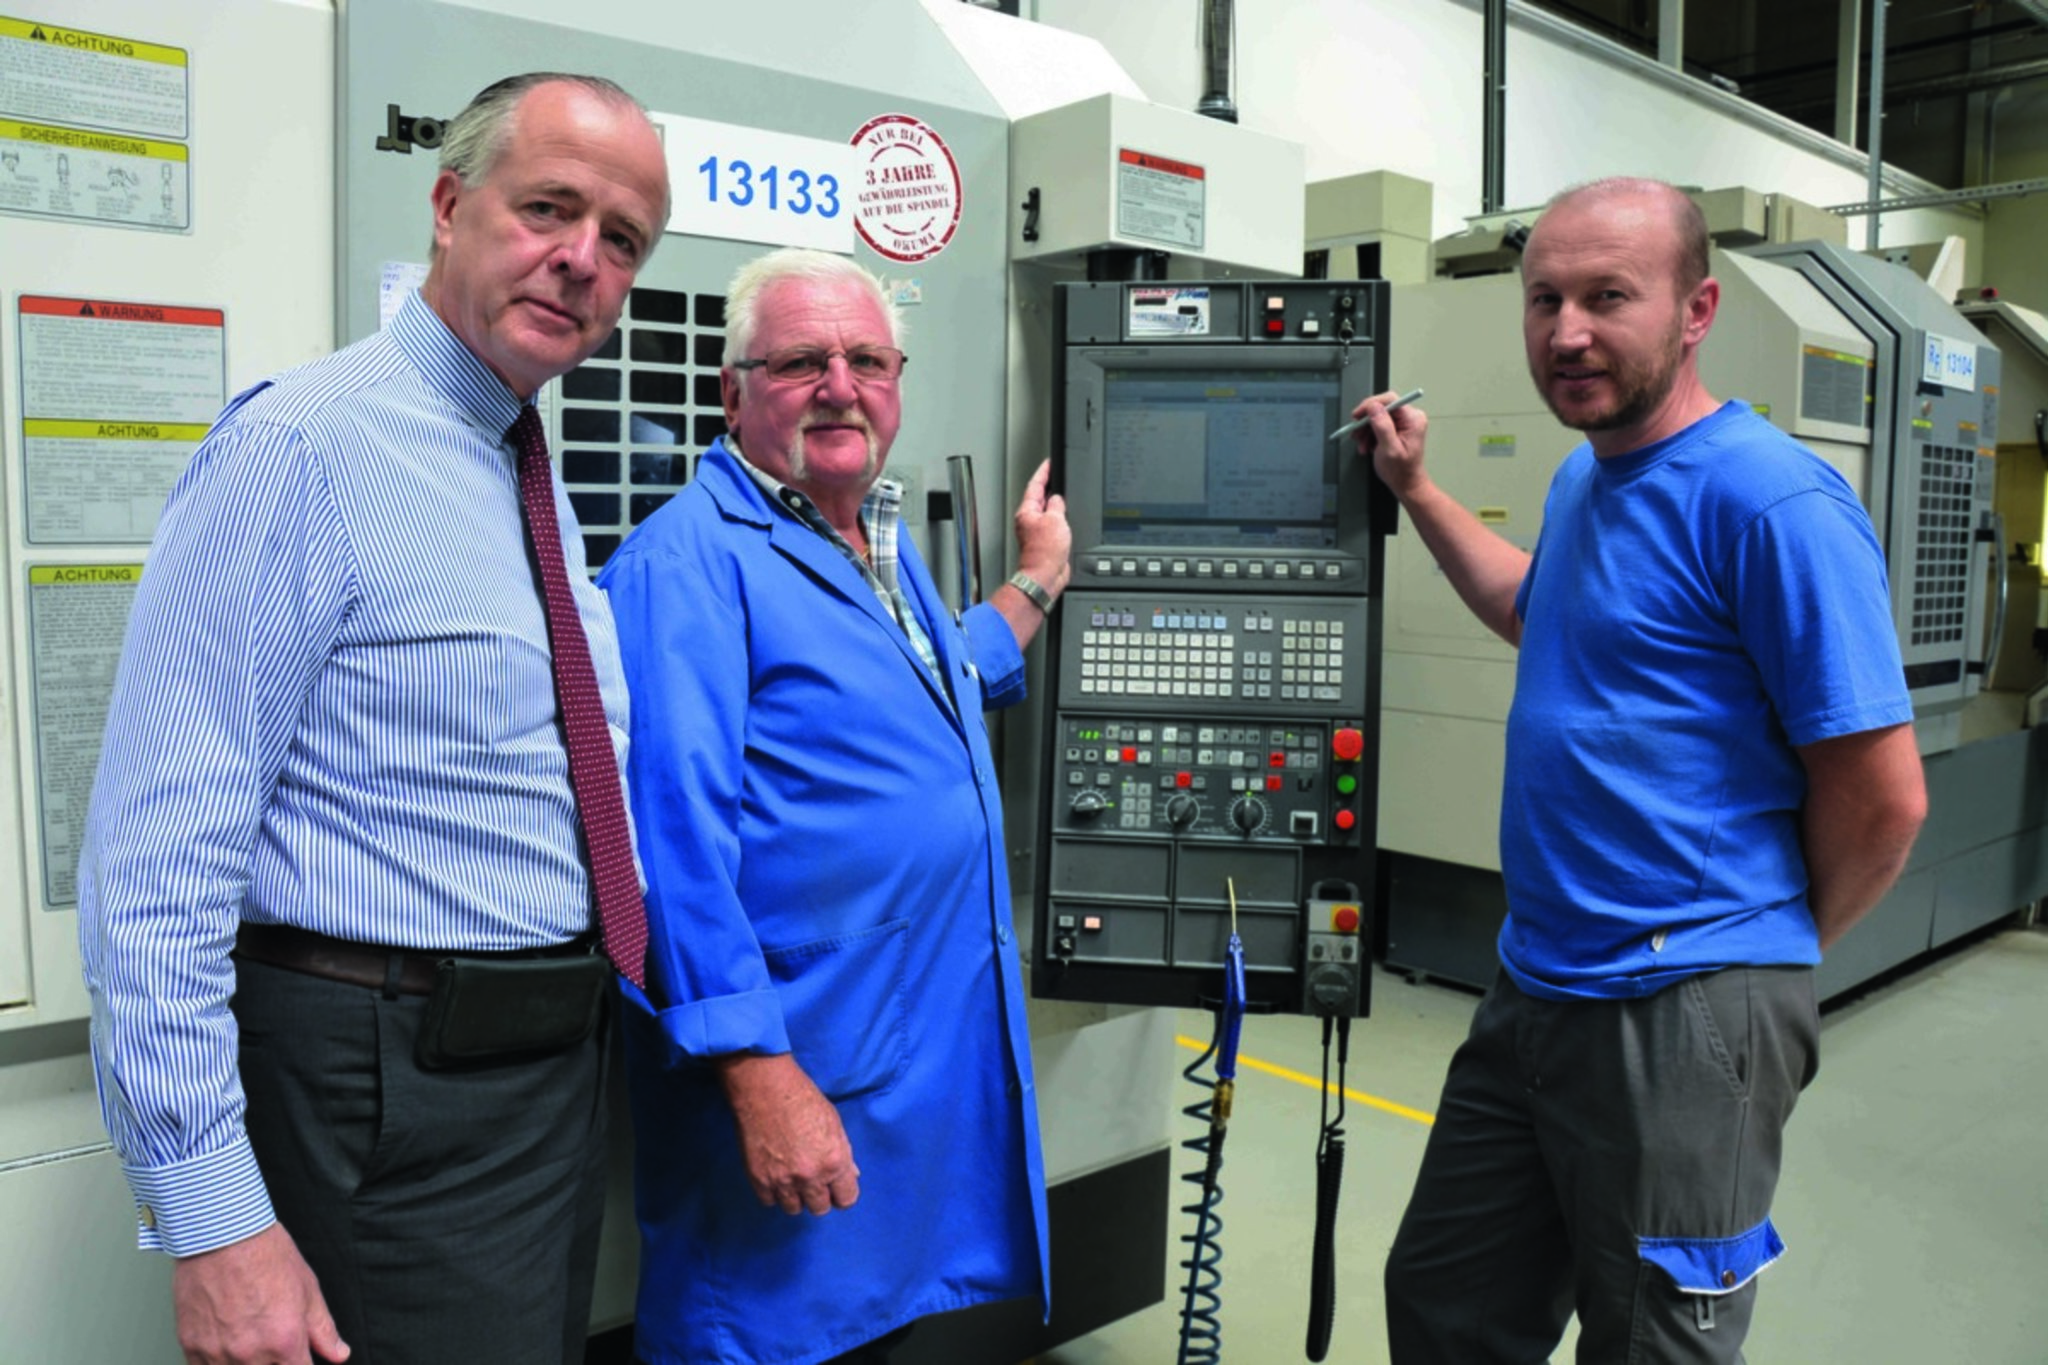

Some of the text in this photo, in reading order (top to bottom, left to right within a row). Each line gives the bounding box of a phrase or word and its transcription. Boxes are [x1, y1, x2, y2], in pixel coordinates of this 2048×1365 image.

[52, 31, 135, 57] ACHTUNG
[20, 126, 147, 156] SICHERHEITSANWEISUNG
[868, 128, 923, 147] NUR BEI
[865, 163, 937, 186] 3 JAHRE
[699, 155, 841, 219] 13133
[858, 184, 949, 203] GEWÄHRLEISTUNG
[862, 198, 950, 218] AUF DIE SPINDEL
[893, 232, 936, 251] OKUMA
[100, 304, 164, 321] WARNUNG
[97, 424, 160, 439] ACHTUNG
[53, 568, 132, 583] ACHTUNG
